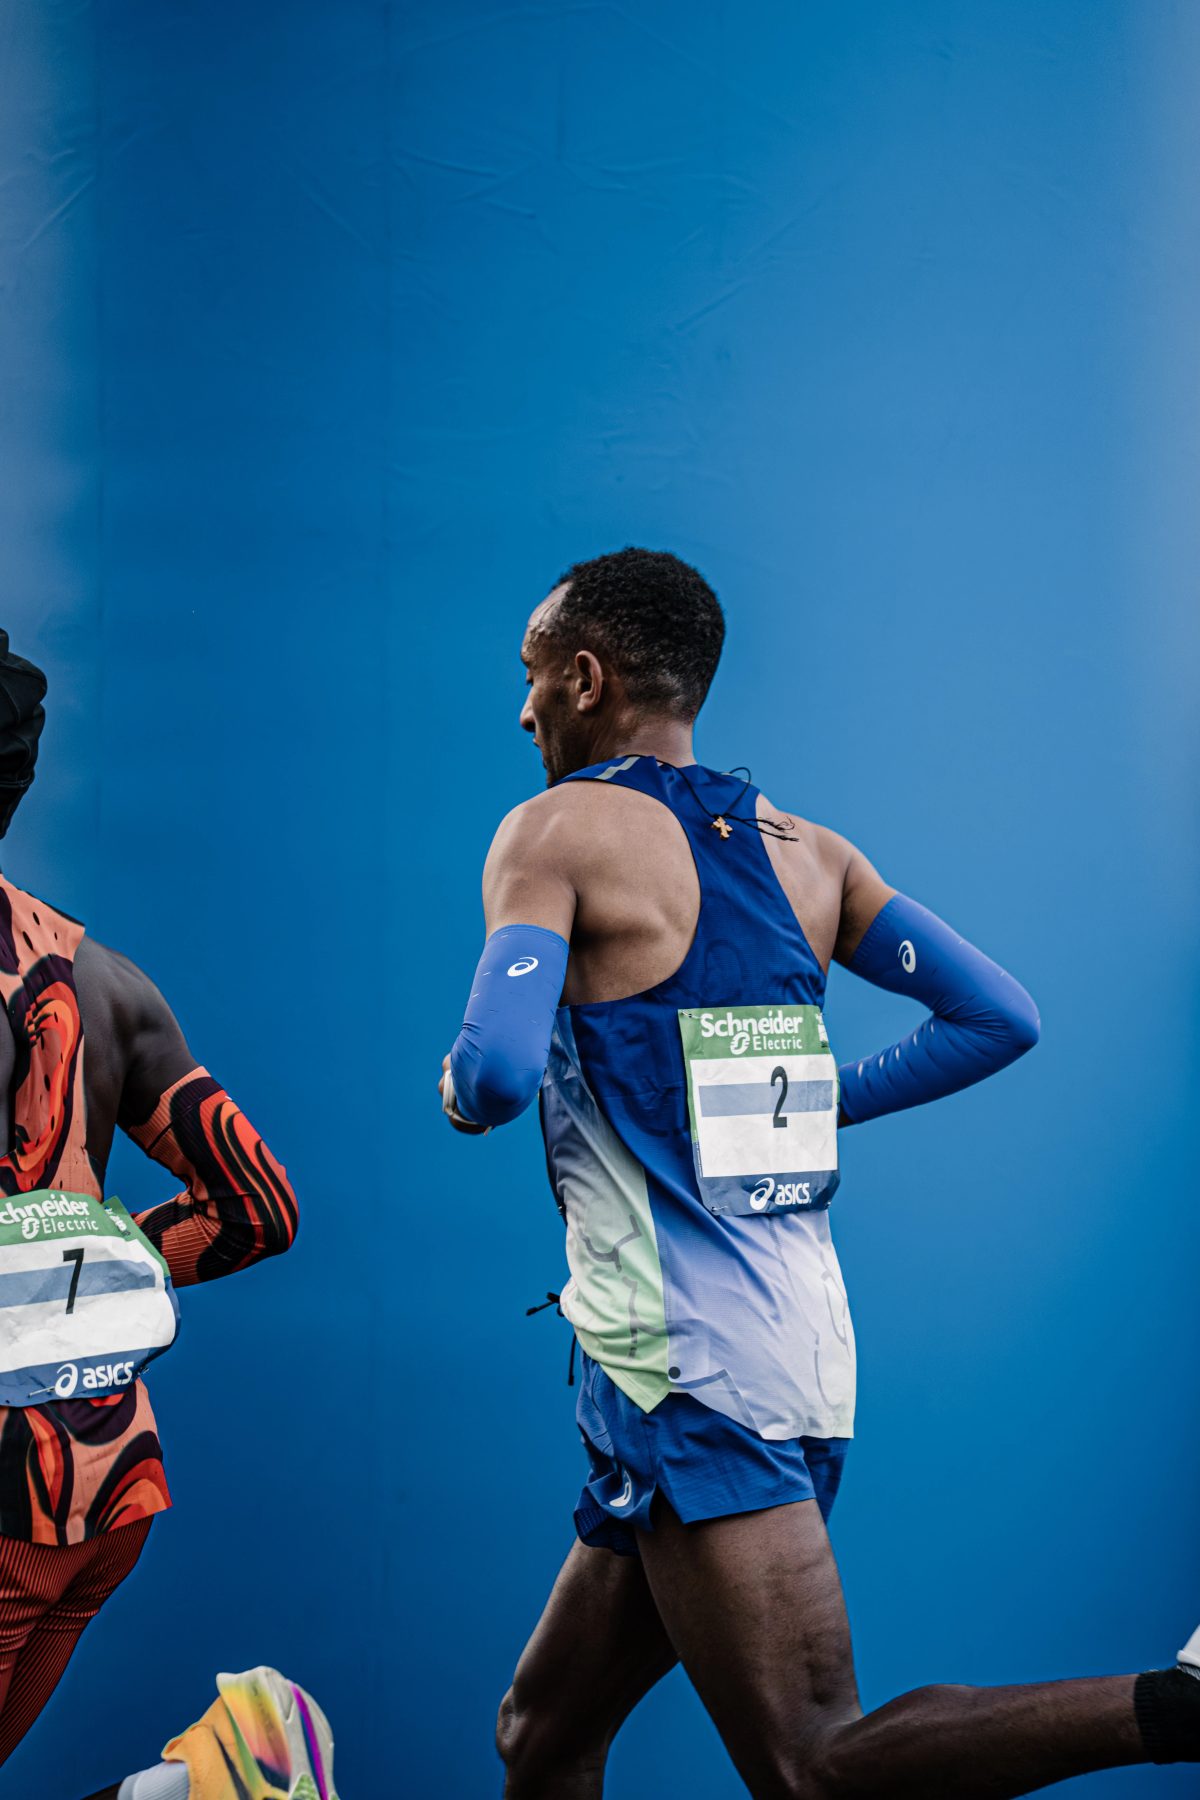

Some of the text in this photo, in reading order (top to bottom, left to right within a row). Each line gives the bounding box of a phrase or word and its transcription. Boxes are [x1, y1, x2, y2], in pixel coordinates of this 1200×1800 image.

[701, 1010, 803, 1038] Schneider
[753, 1035, 803, 1051] Electric
[770, 1065, 788, 1129] 2
[0, 1193, 91, 1225] chneider
[42, 1217, 99, 1235] Electric
[62, 1247, 85, 1315] 7
